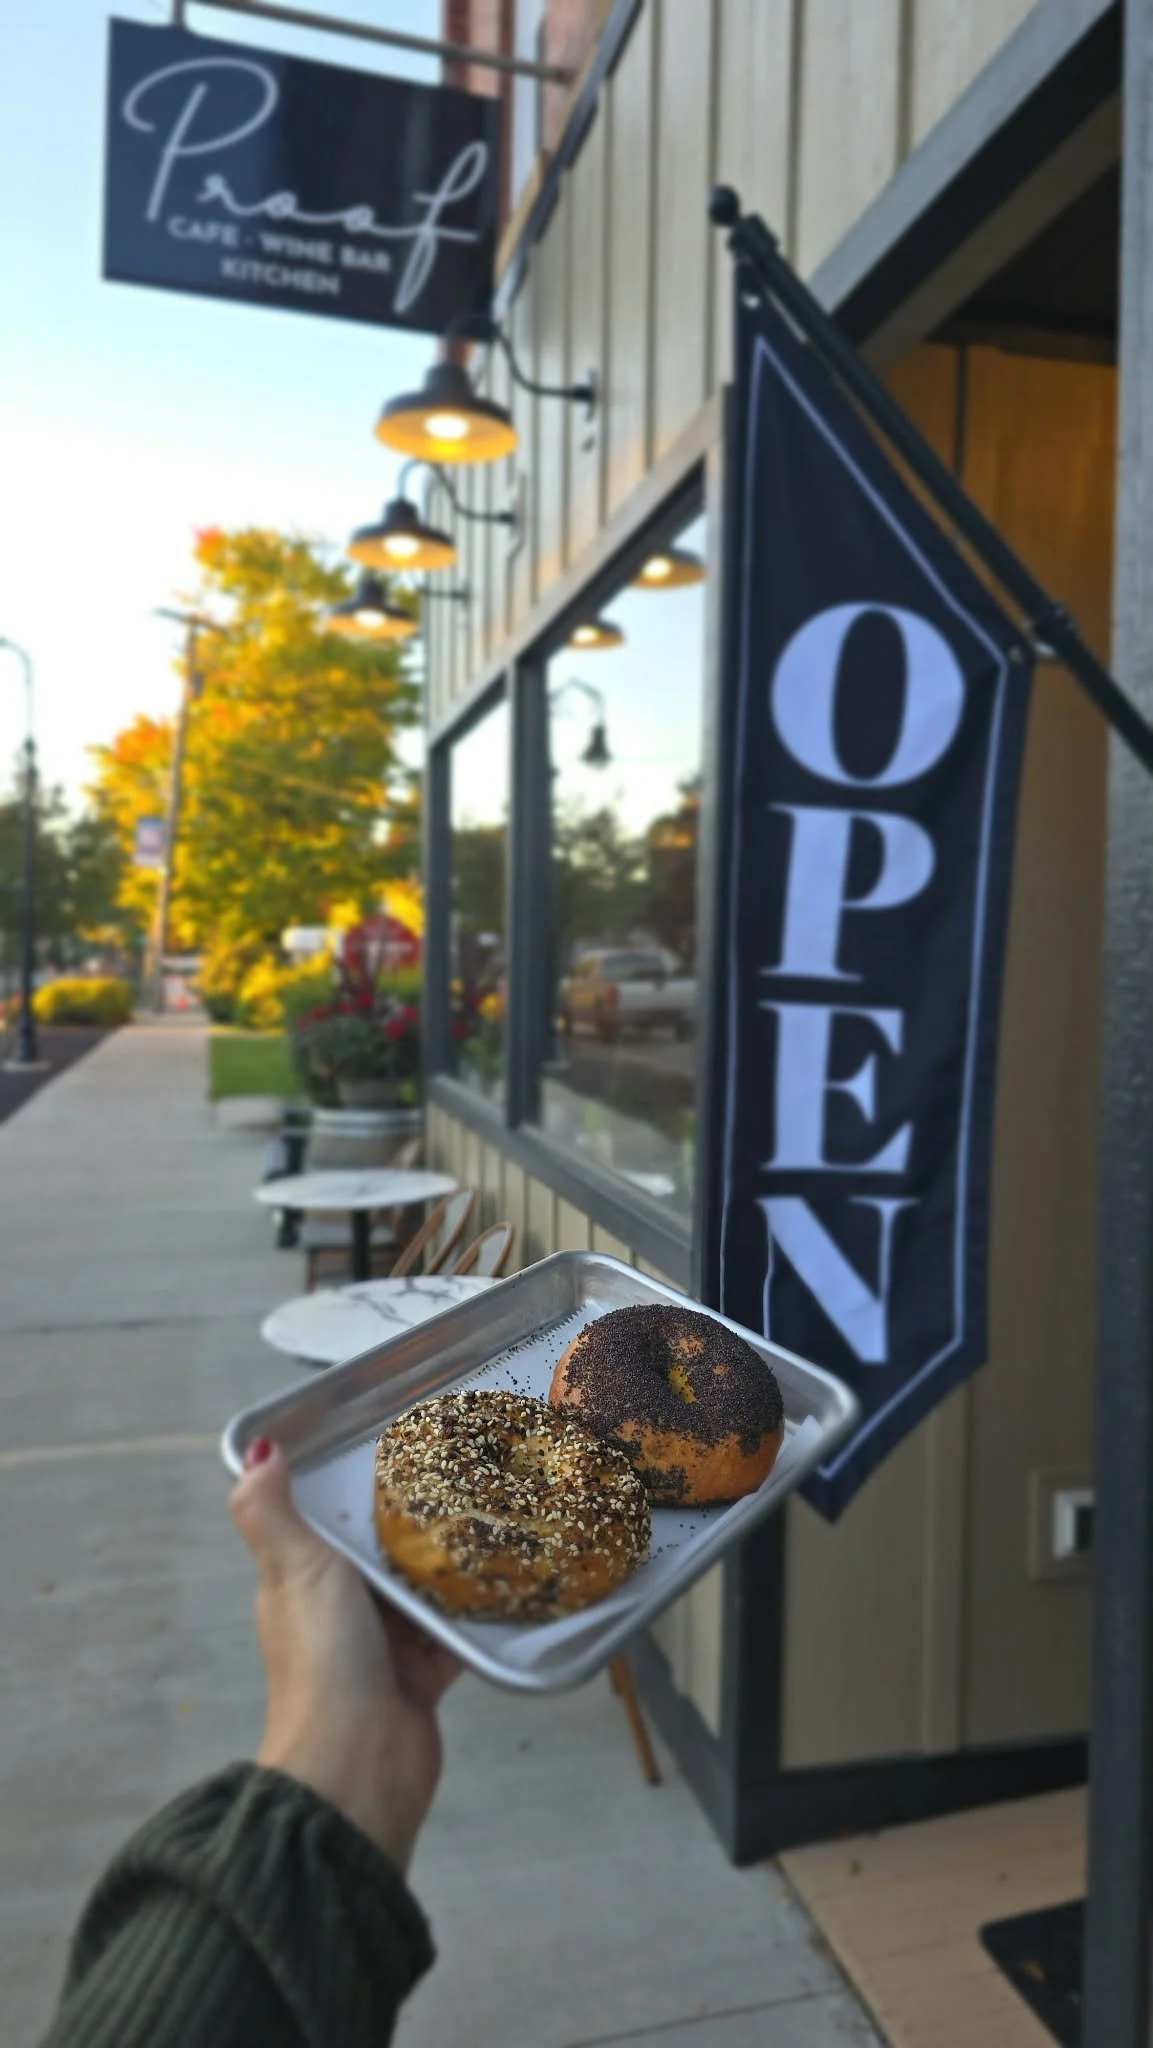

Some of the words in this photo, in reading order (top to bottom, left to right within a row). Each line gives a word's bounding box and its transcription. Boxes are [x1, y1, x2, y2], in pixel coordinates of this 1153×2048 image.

[123, 57, 488, 314] Proof
[168, 215, 239, 248] CAFE
[258, 231, 334, 265] WINE
[340, 245, 391, 274] BAR
[220, 256, 341, 296] KITCHEN
[756, 602, 966, 1363] OPEN
